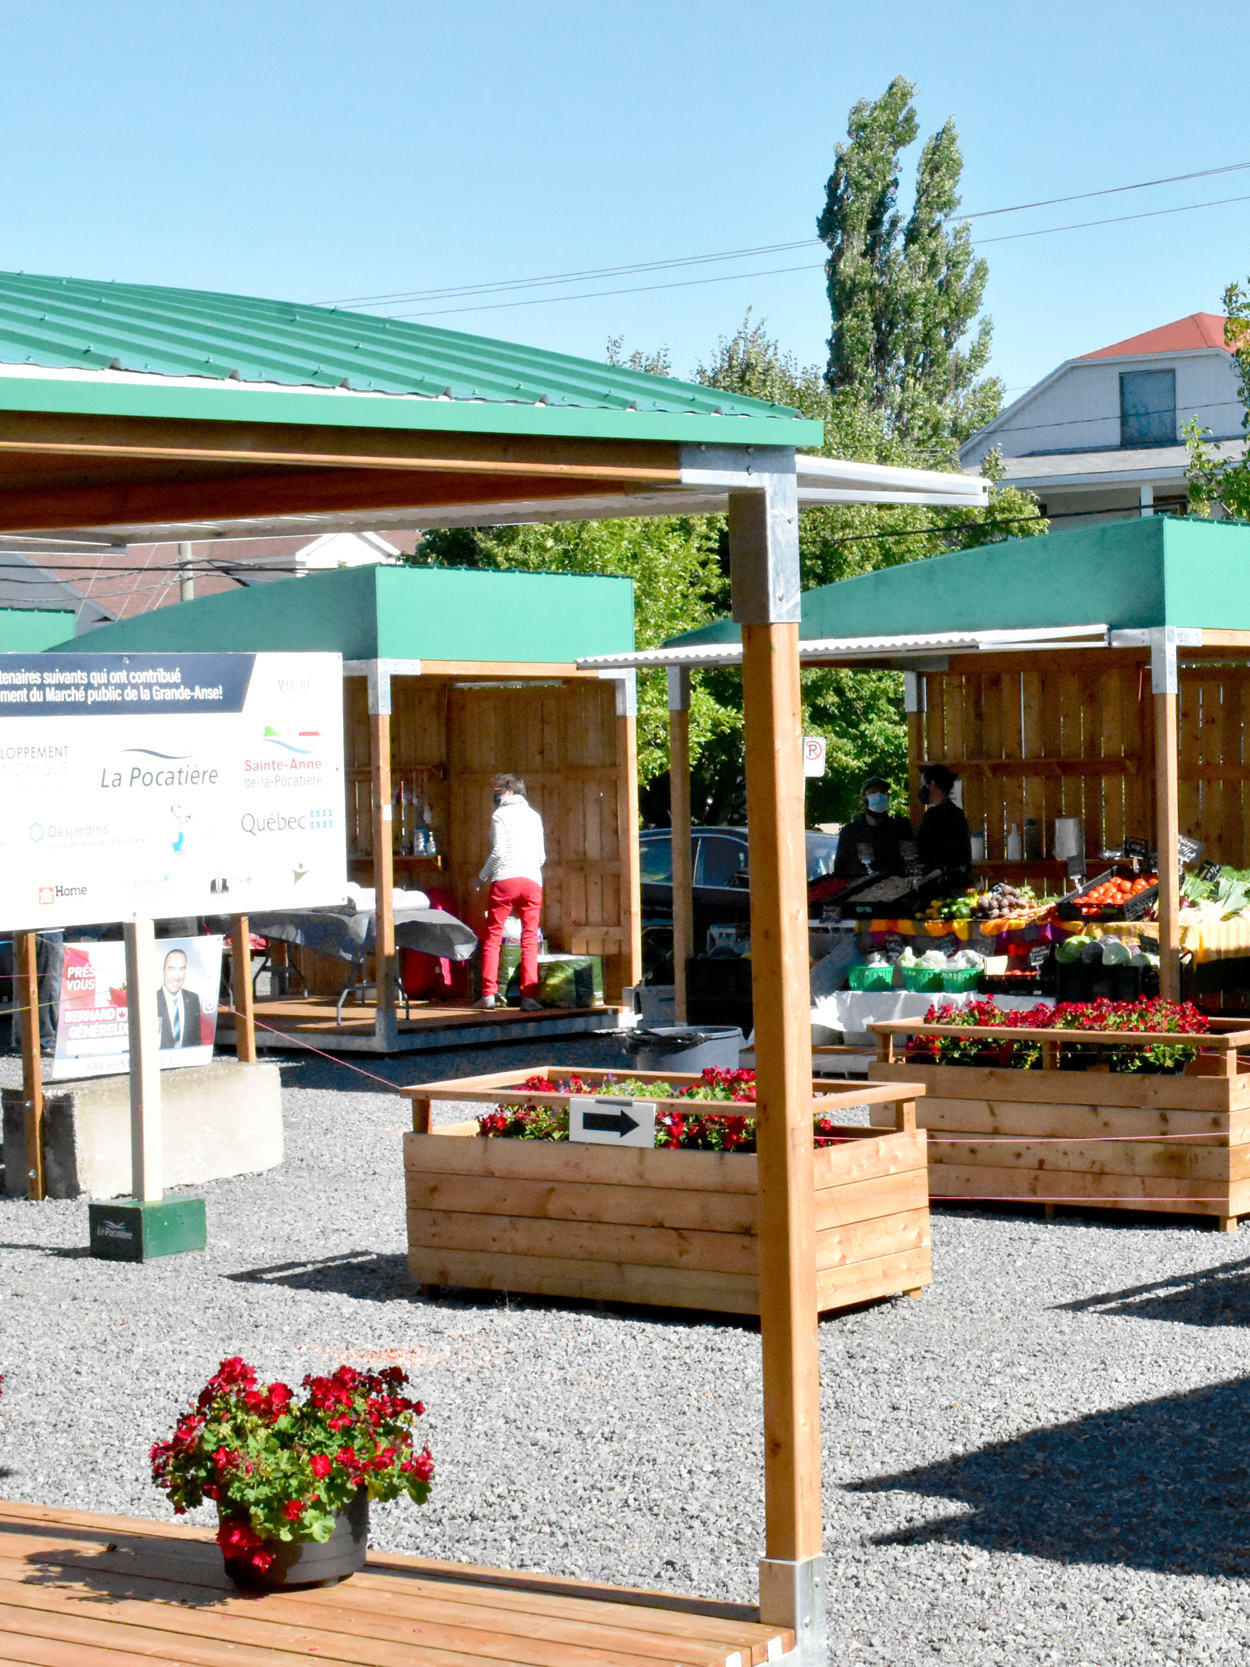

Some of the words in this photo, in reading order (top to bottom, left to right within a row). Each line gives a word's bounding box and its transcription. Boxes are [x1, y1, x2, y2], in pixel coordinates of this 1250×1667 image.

[43, 668, 88, 685] suivants
[90, 669, 107, 687] qui
[109, 669, 128, 684] ont
[130, 668, 181, 684] contribué
[0, 688, 28, 703] ment
[30, 687, 43, 702] du
[45, 686, 84, 702] Marché
[88, 685, 122, 704] public
[124, 685, 138, 701] de
[140, 685, 151, 700] la
[153, 685, 223, 700] Grande-Anse!
[0, 745, 69, 760] LOPPEMENT
[244, 758, 322, 772] Sainte-Anne
[101, 767, 122, 788] La
[129, 764, 219, 788] Pocatière
[48, 823, 109, 840] Desjardins
[241, 812, 307, 837] Québec
[55, 884, 88, 898] Home
[67, 978, 96, 991] VOUS
[65, 1008, 116, 1023] BERNARD
